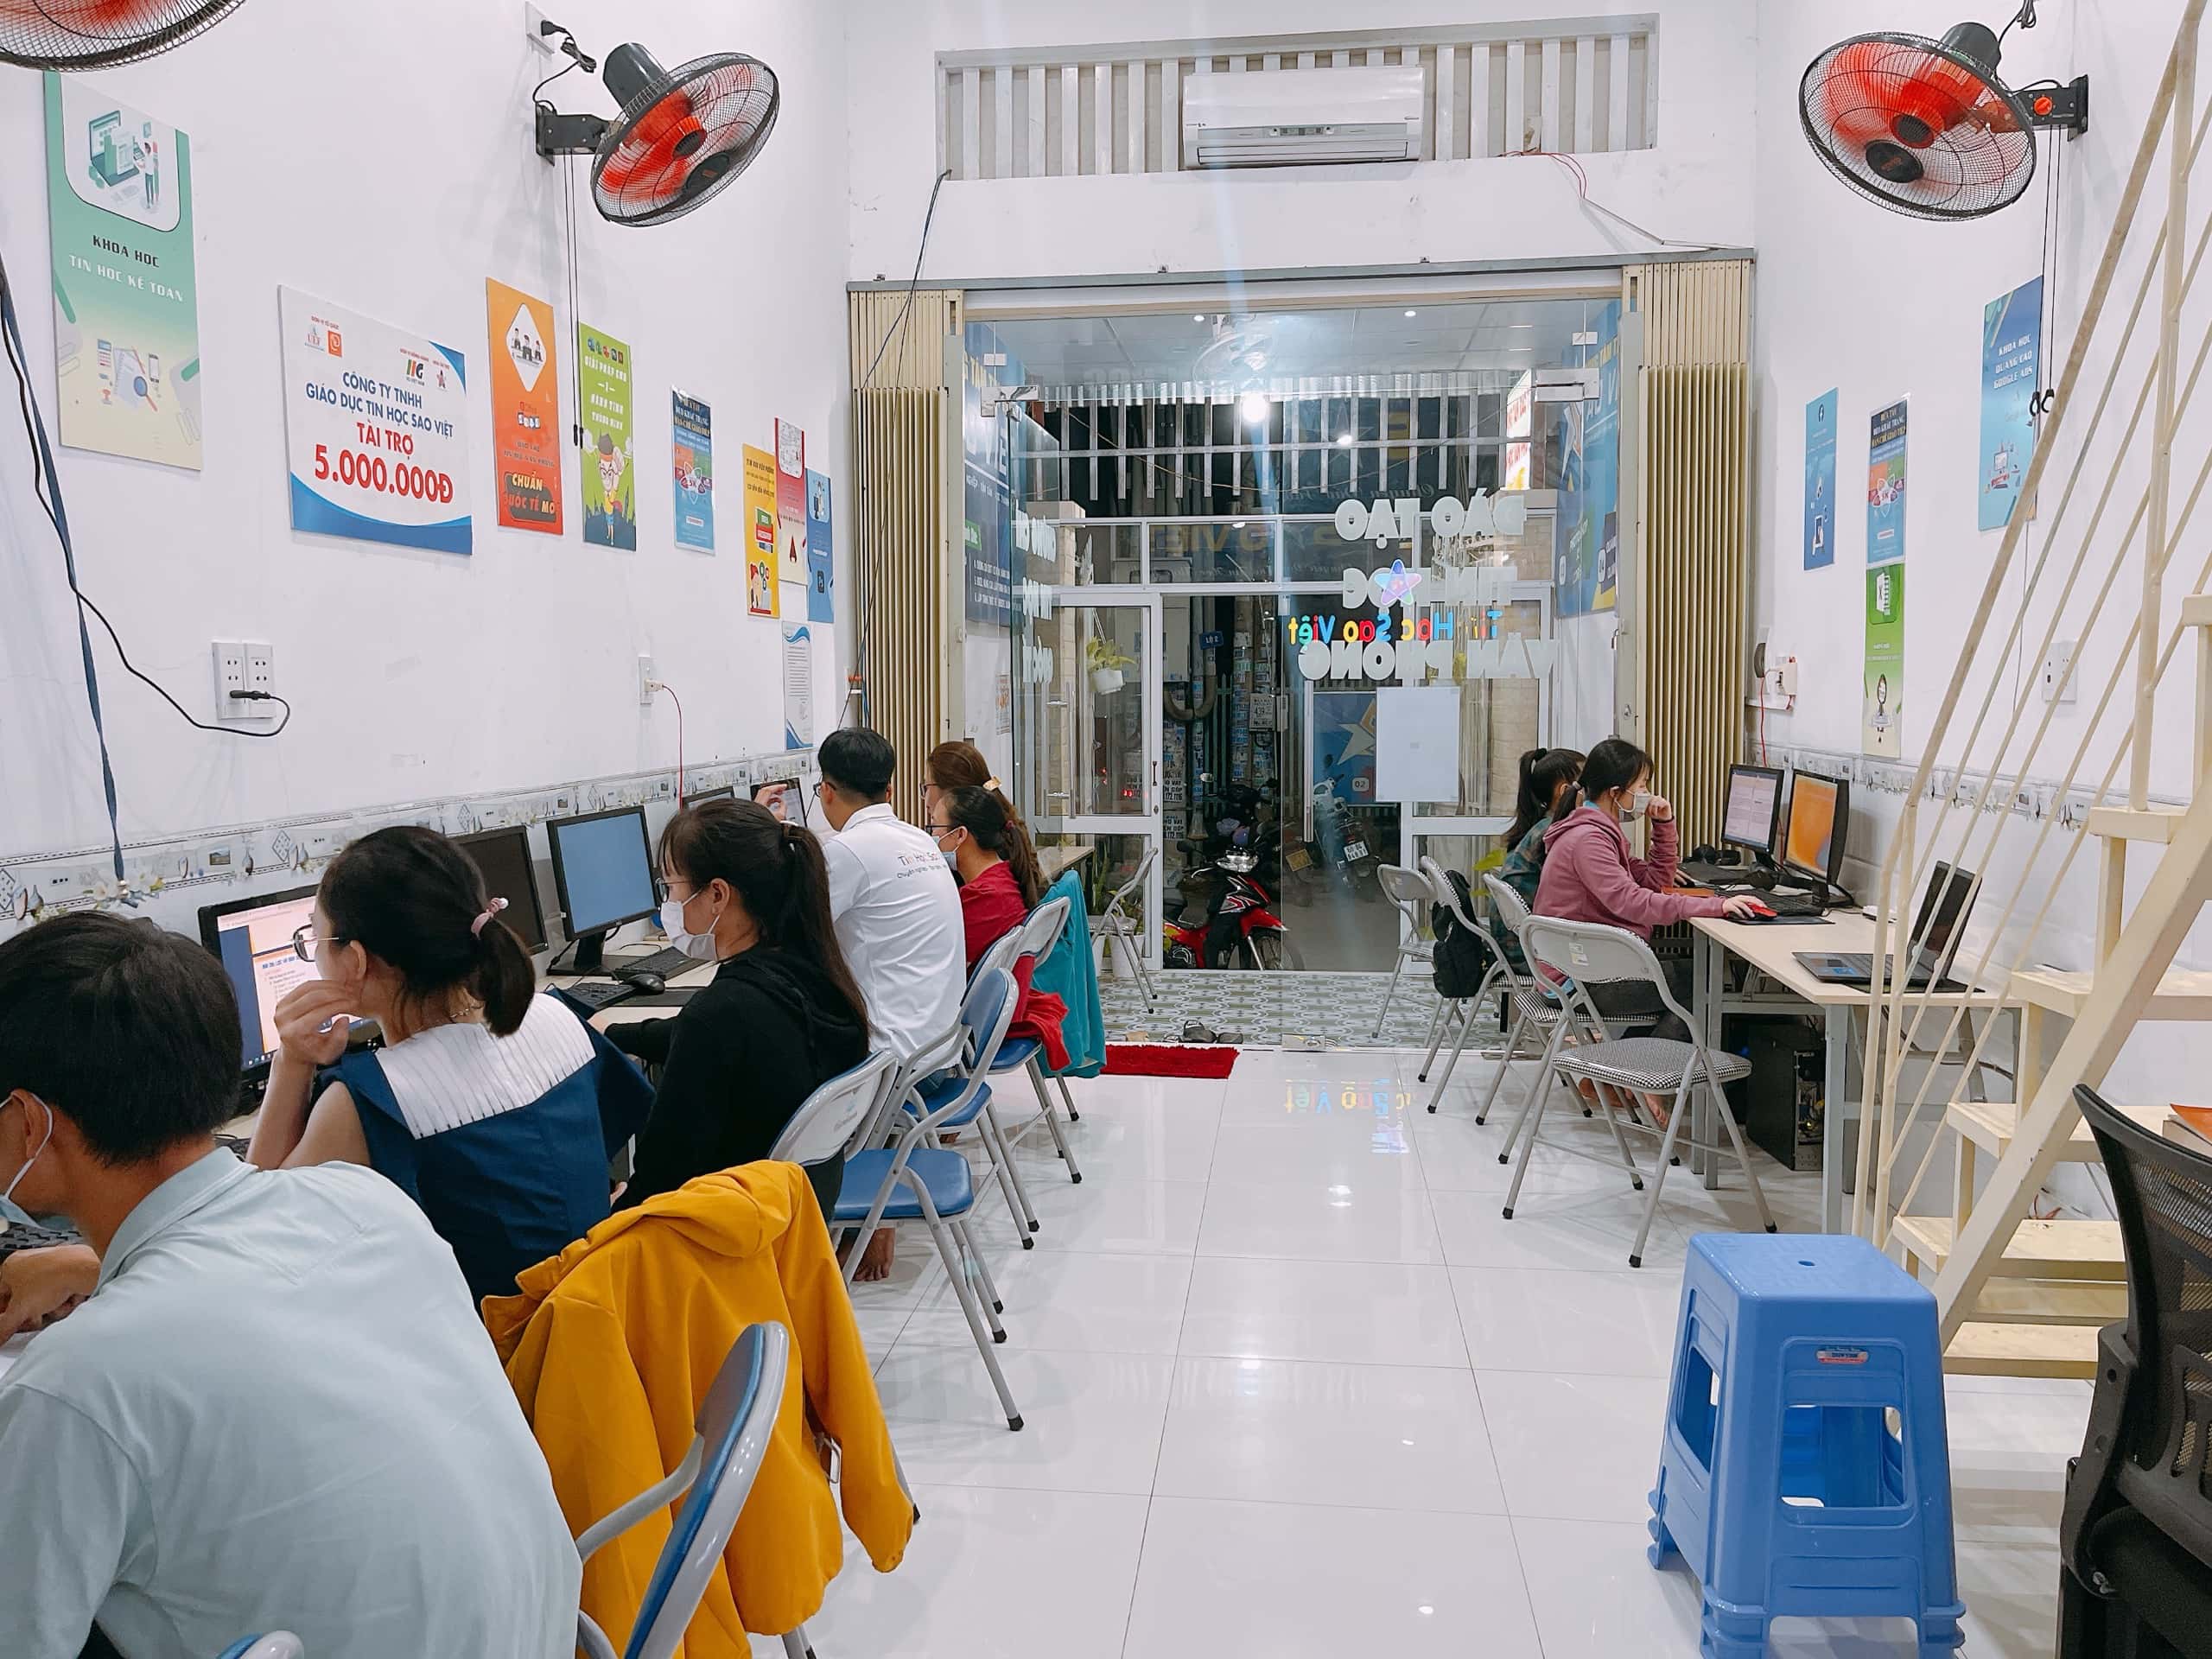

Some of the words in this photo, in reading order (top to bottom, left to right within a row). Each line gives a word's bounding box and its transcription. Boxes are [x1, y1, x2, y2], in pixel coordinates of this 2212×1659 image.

[306, 383, 337, 405] GIÁO
[340, 392, 363, 414] DỤC
[366, 400, 384, 419] TIN
[386, 406, 409, 427] HỌC
[411, 413, 432, 432] SAO
[434, 420, 454, 439] VIỆT
[342, 371, 376, 395] CÔNG
[378, 383, 391, 399] TY
[394, 388, 423, 410] TNHH
[357, 419, 381, 448] TÀI
[385, 429, 414, 460] TRỢ
[315, 443, 454, 504] 5.000.000Đ
[512, 470, 543, 492] CHUẨN
